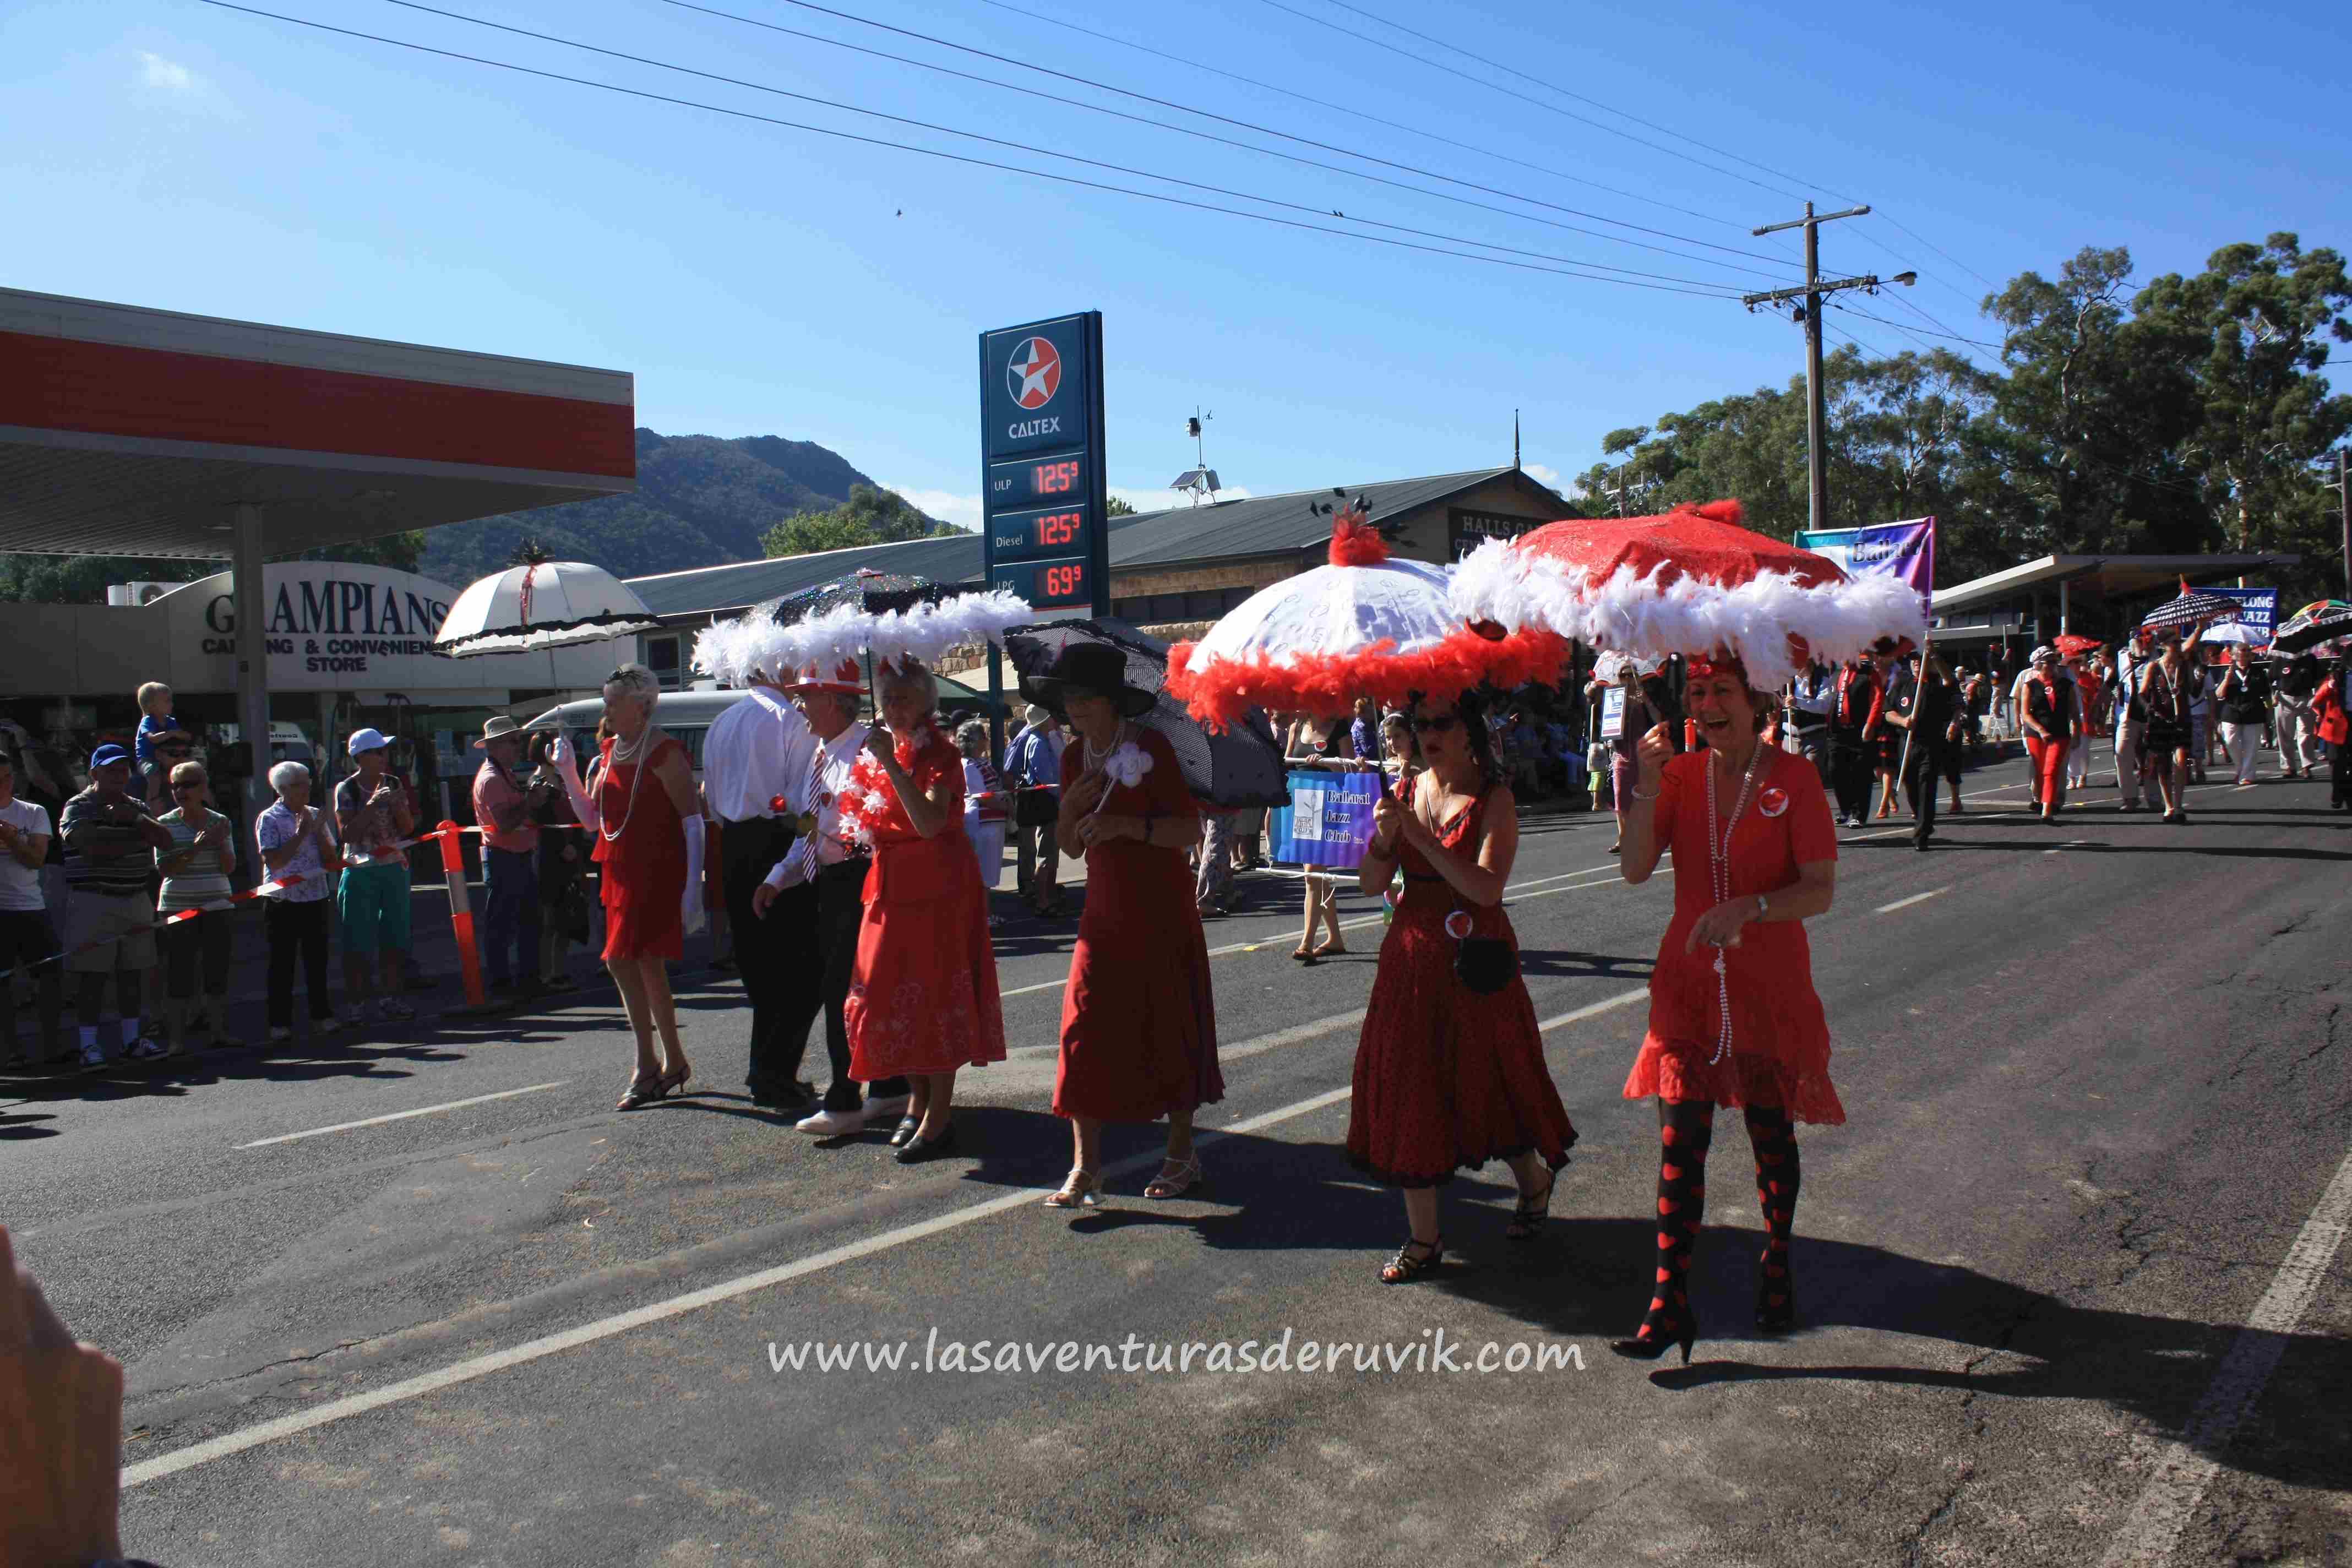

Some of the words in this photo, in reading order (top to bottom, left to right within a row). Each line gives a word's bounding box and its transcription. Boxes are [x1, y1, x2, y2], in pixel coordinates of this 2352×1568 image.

[1009, 416, 1060, 439] CALTEX
[995, 480, 1011, 491] ULP
[1462, 516, 1510, 536] HALLS
[996, 534, 1022, 547] Diesel
[997, 580, 1015, 592] LPG
[206, 581, 450, 635] GAMPIANS
[202, 639, 294, 654] CANG
[305, 639, 320, 654] &
[327, 639, 434, 656] CONVENIEN
[307, 657, 367, 672] STORE
[1327, 790, 1370, 804] Ballarat
[1326, 810, 1351, 824] Jazz
[1325, 830, 1351, 843] Club
